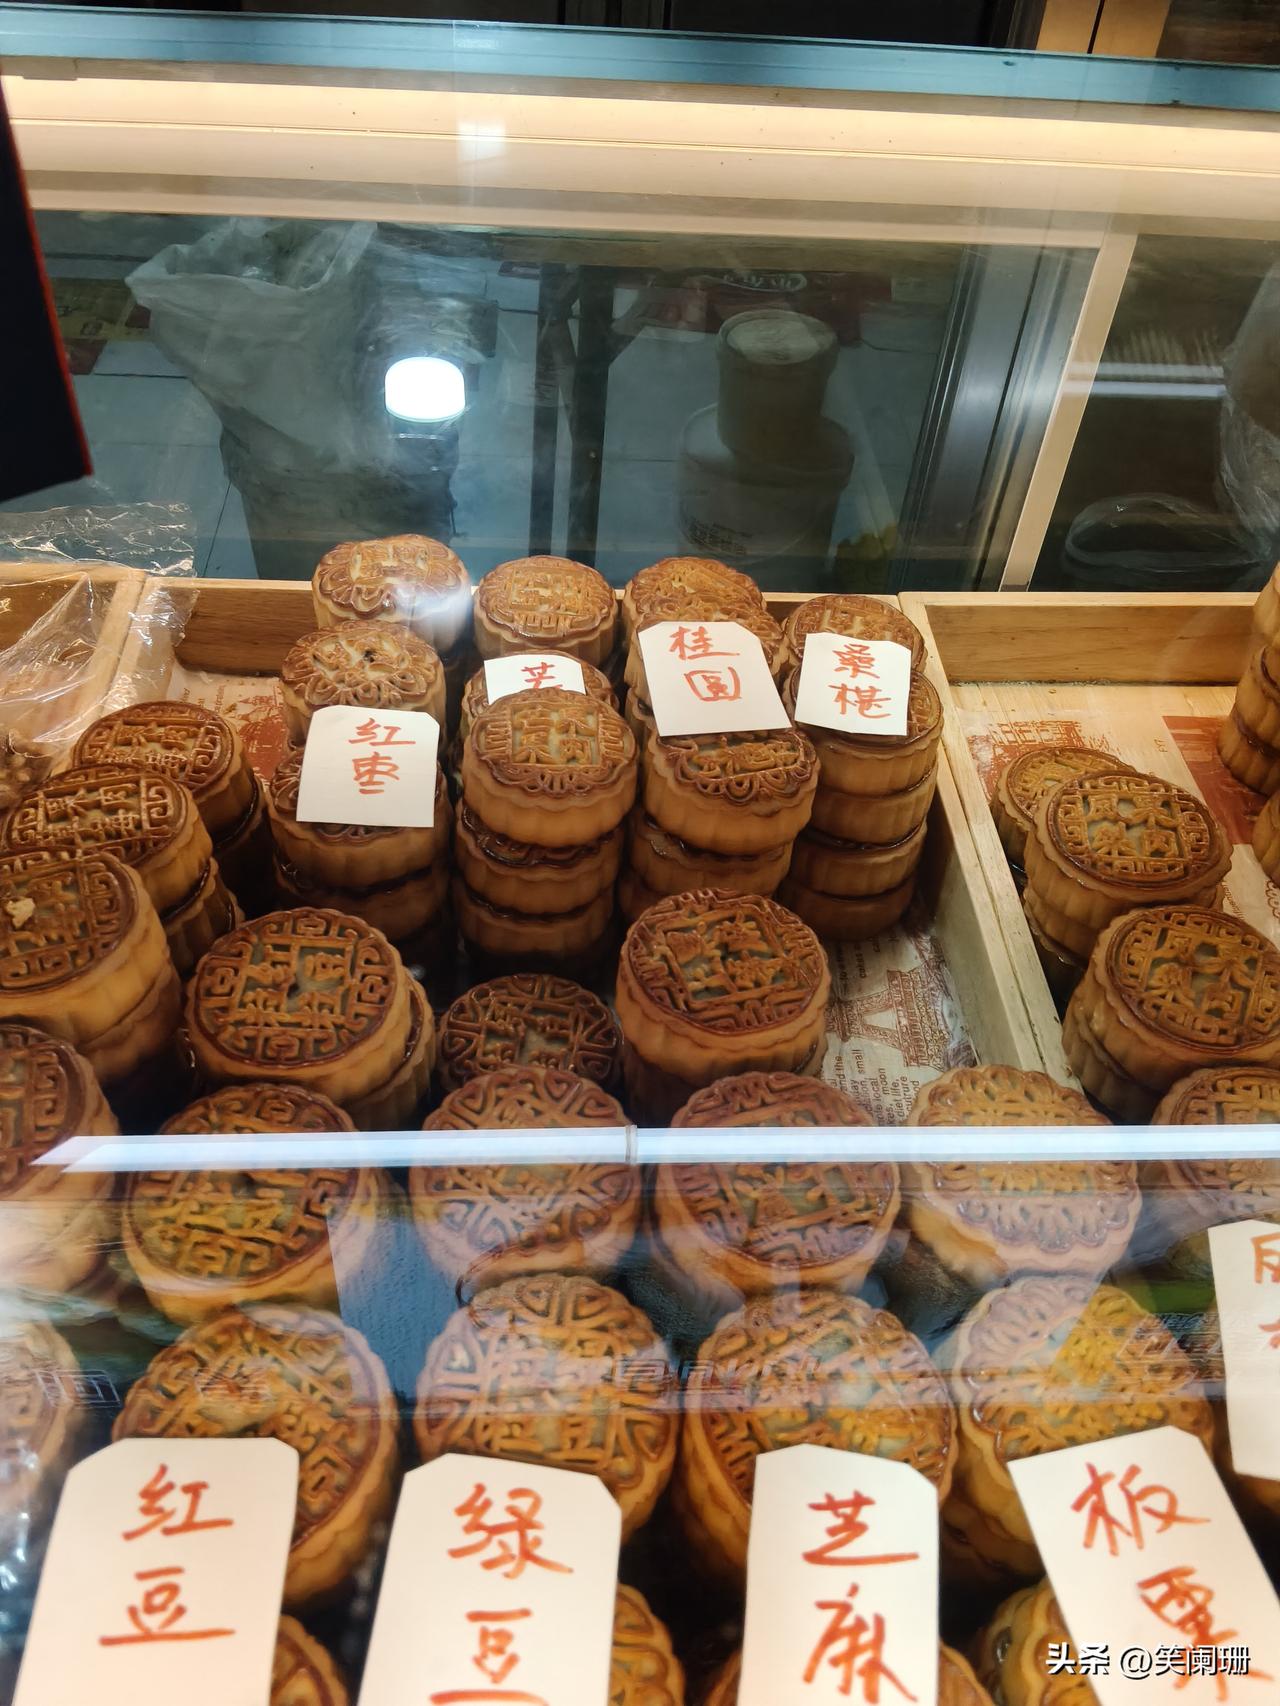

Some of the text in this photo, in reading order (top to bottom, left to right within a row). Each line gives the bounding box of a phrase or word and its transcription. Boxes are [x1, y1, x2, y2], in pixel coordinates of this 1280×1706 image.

[669, 626, 741, 702] 桂圆
[348, 718, 416, 795] 红枣
[850, 1049, 866, 1075] small
[865, 1077, 882, 1102] local
[878, 1067, 891, 1096] moon
[98, 1463, 236, 1648] 红豆
[429, 1482, 573, 1706] 绿豆
[1070, 1462, 1276, 1702] 板栗
[801, 1490, 918, 1706] 芝麻
